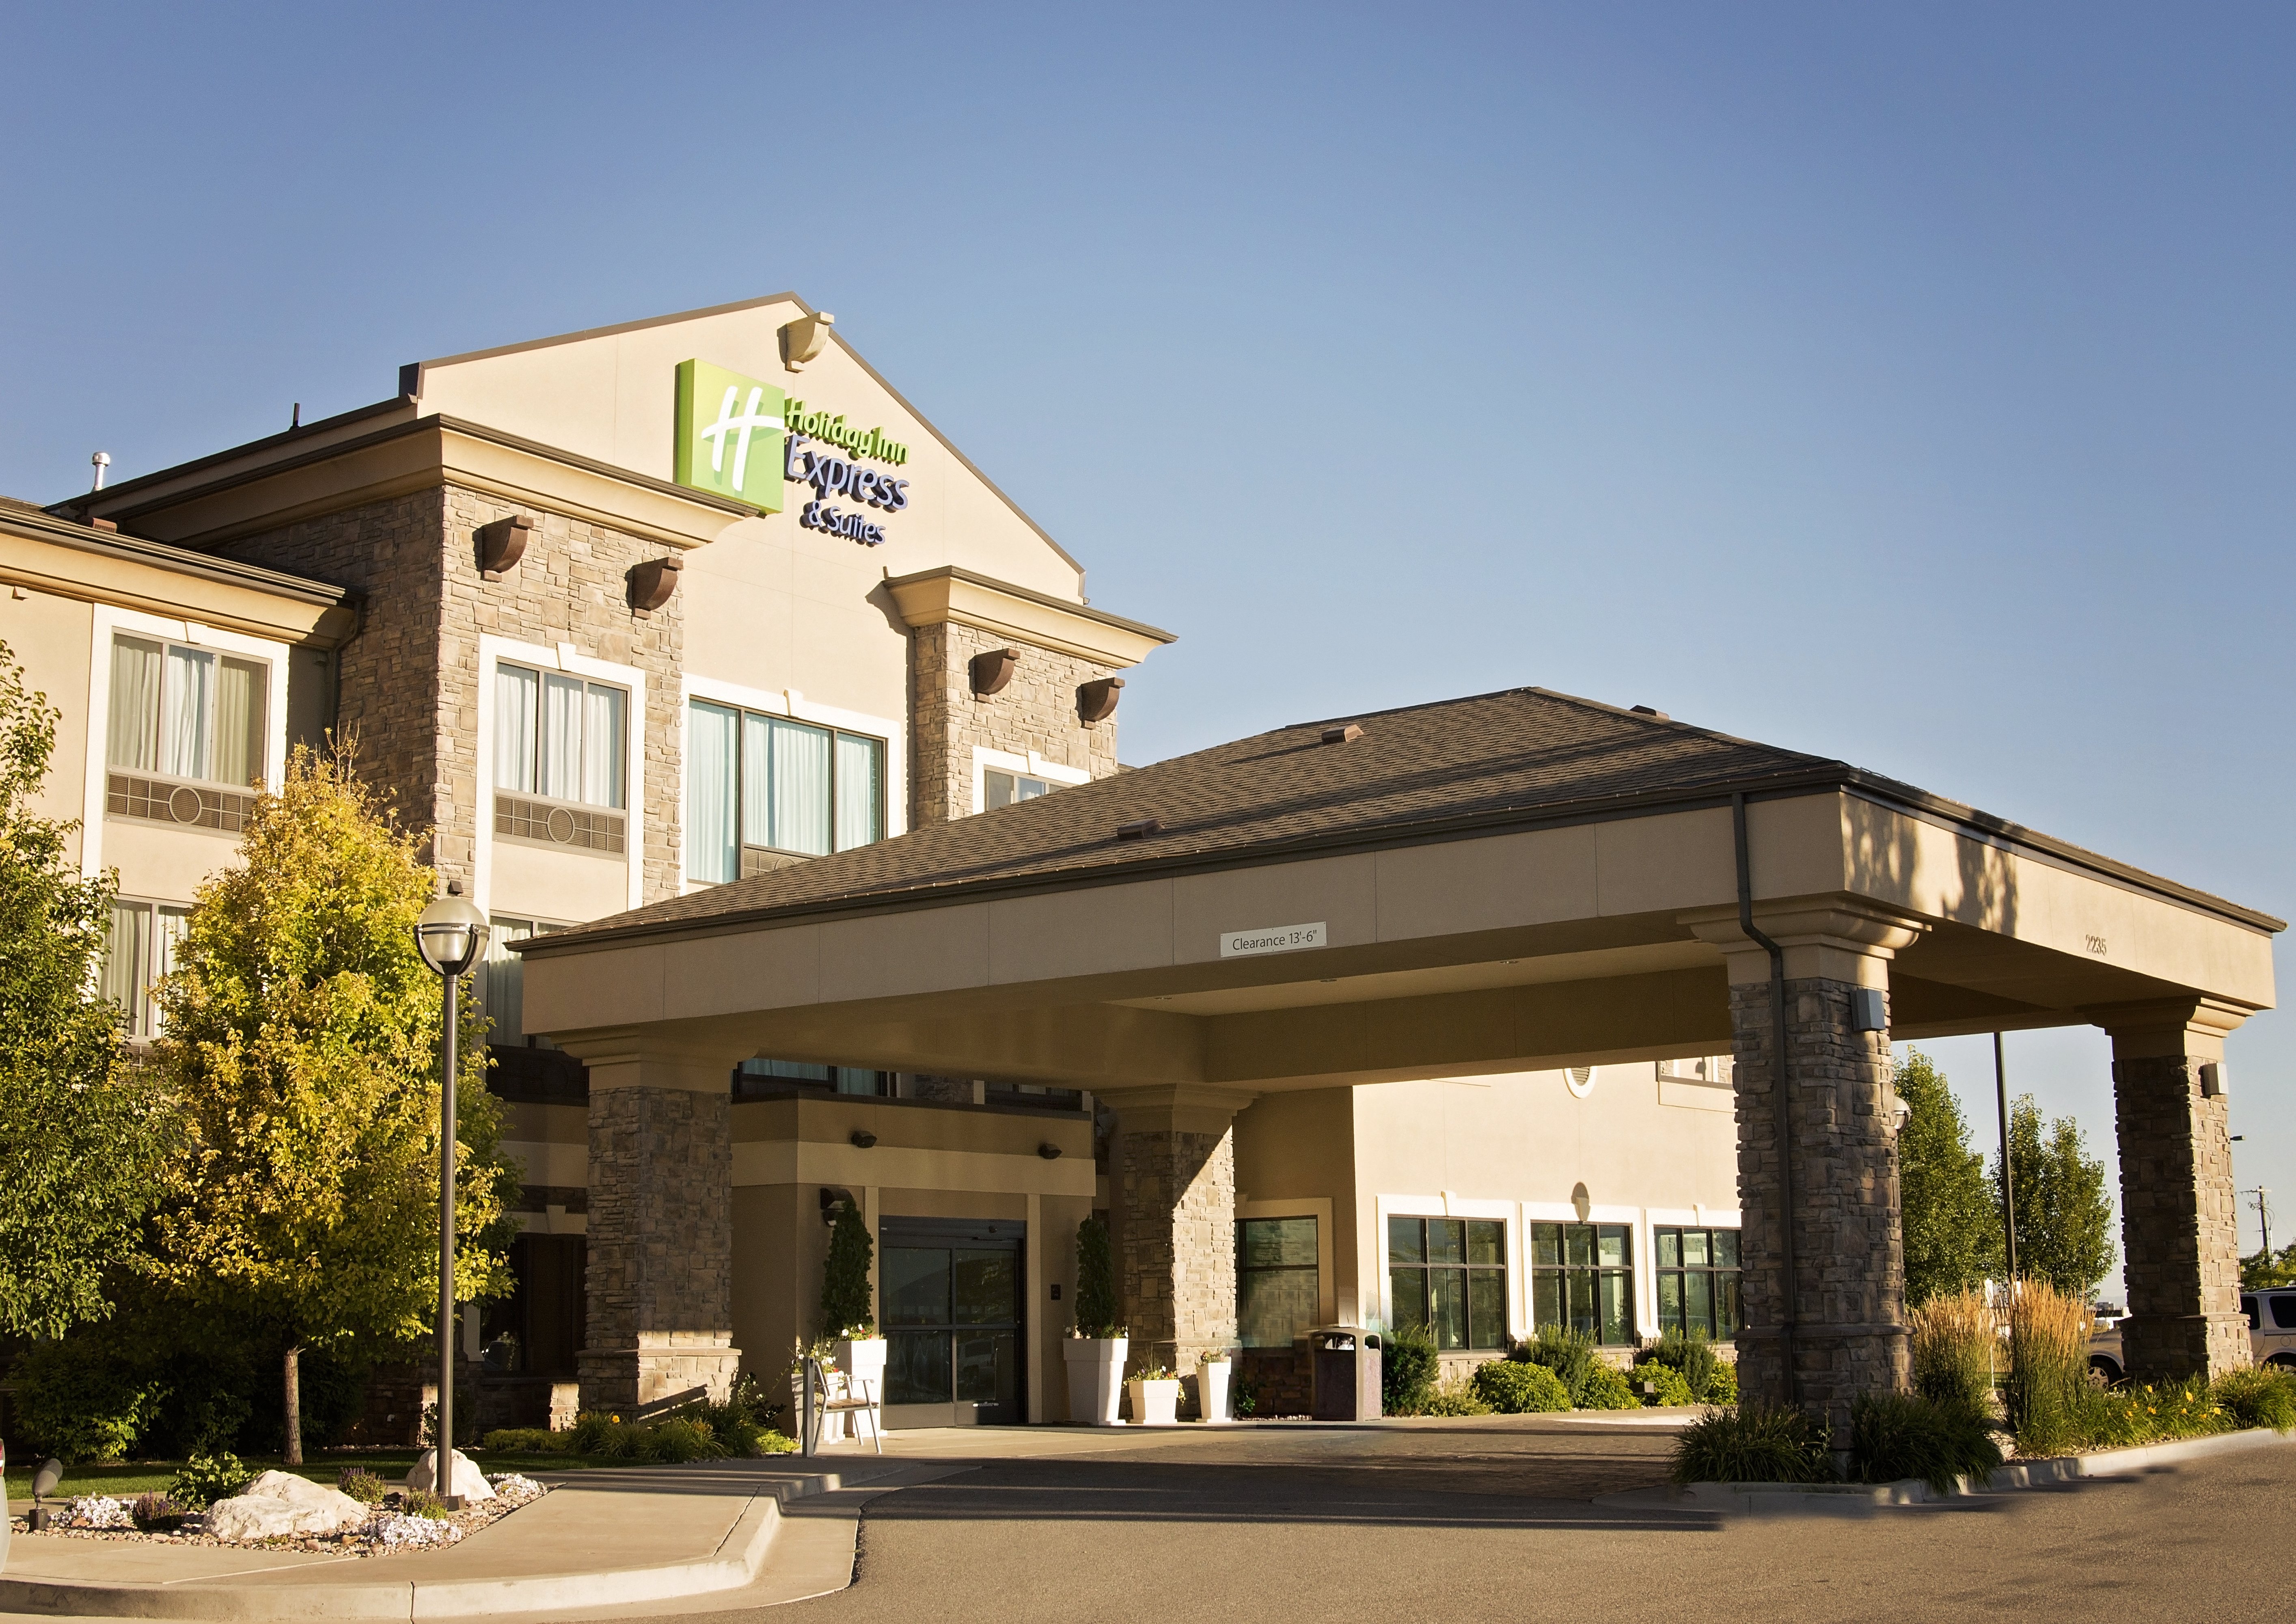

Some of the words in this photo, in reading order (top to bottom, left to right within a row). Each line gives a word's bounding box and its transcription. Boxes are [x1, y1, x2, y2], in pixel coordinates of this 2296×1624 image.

[786, 397, 874, 458] Holiday
[875, 426, 909, 464] Inn
[787, 434, 910, 510] Express
[806, 500, 823, 527] &
[826, 505, 886, 544] Suites
[1232, 936, 1285, 950] Clearance
[1288, 929, 1317, 944] 13'-6"
[2086, 934, 2106, 956] 2235
